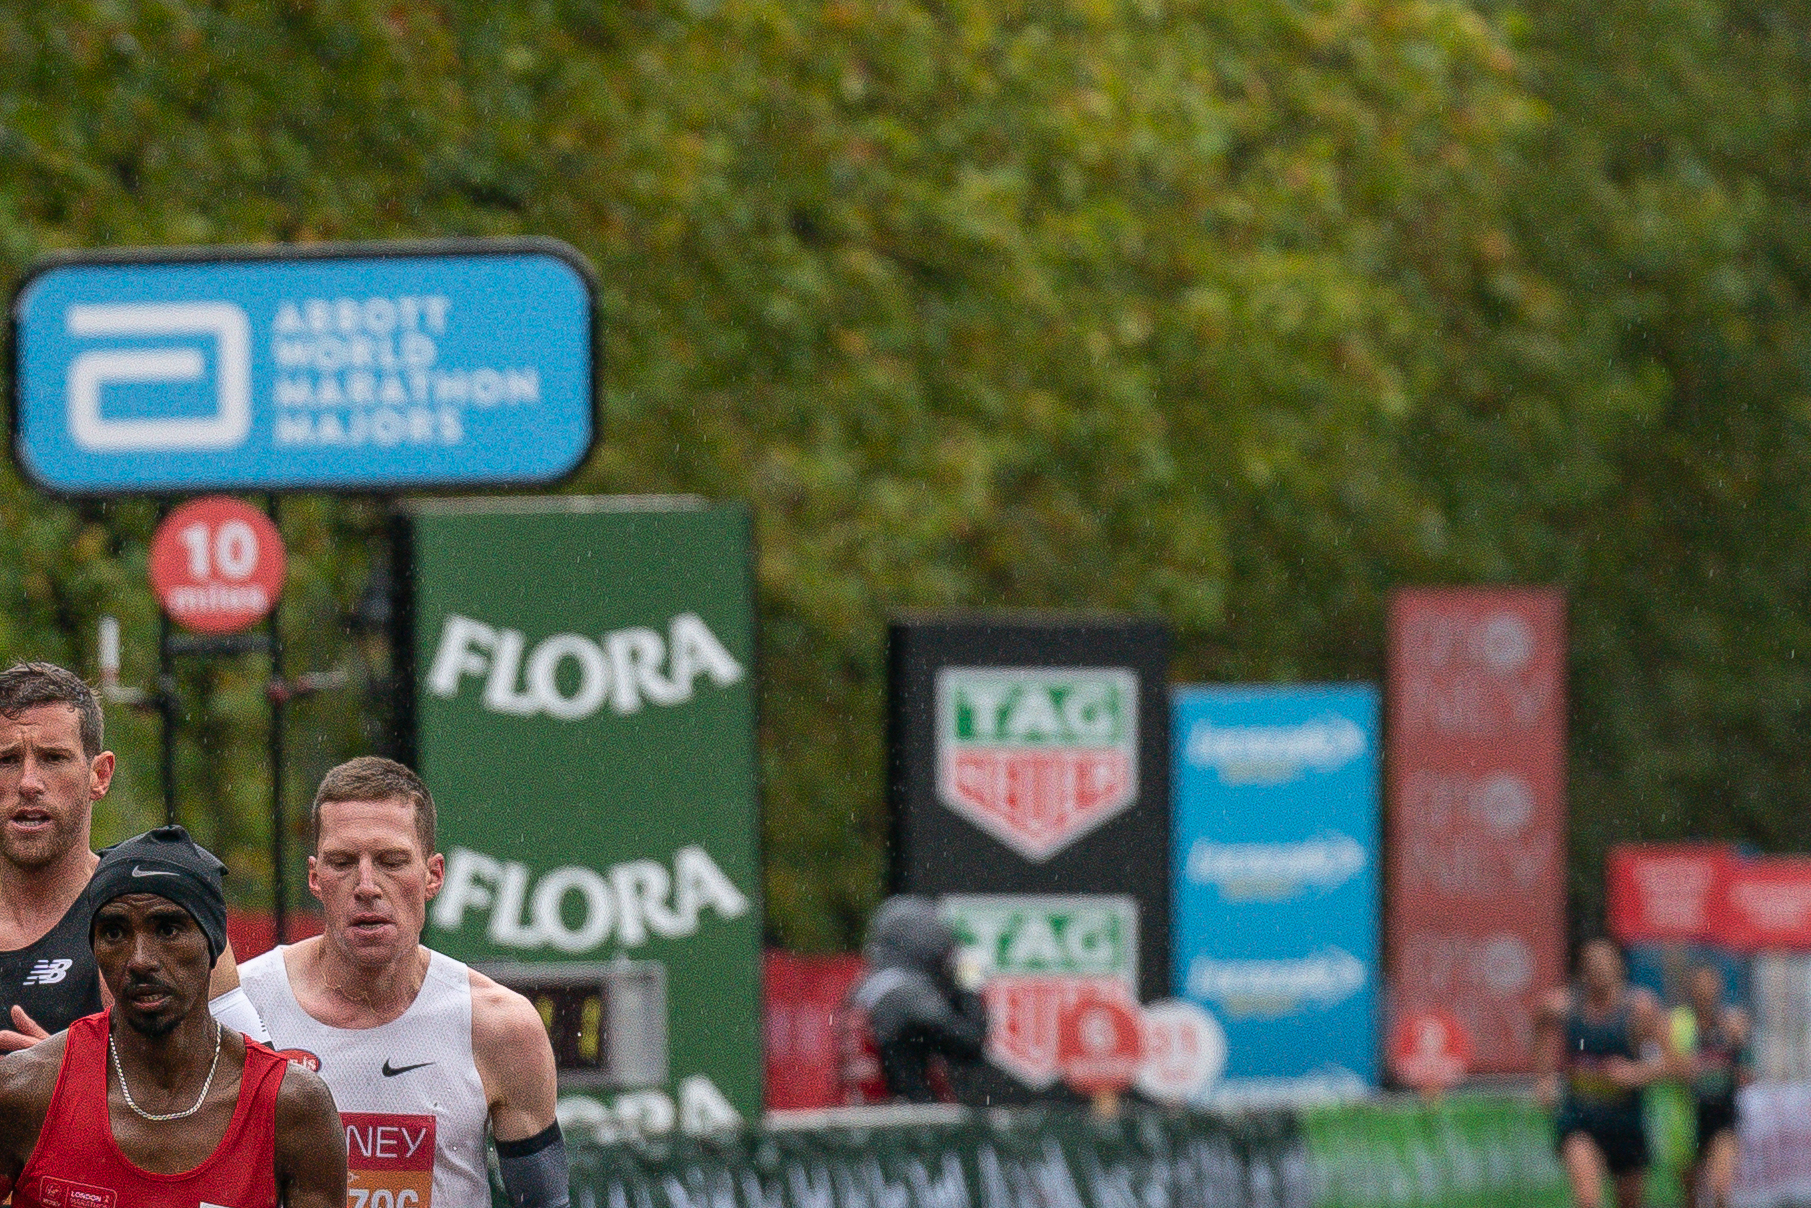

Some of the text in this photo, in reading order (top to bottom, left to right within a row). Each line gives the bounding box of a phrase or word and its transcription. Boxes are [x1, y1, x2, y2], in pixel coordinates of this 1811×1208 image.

[272, 294, 451, 336] ABBOTT
[273, 332, 437, 371] WORLD
[274, 367, 539, 409] MARATHON
[275, 404, 464, 445] MAJORS
[179, 519, 258, 579] 10
[426, 612, 746, 720] FLORA
[431, 845, 749, 953] FLORA
[346, 1125, 427, 1158] NEY
